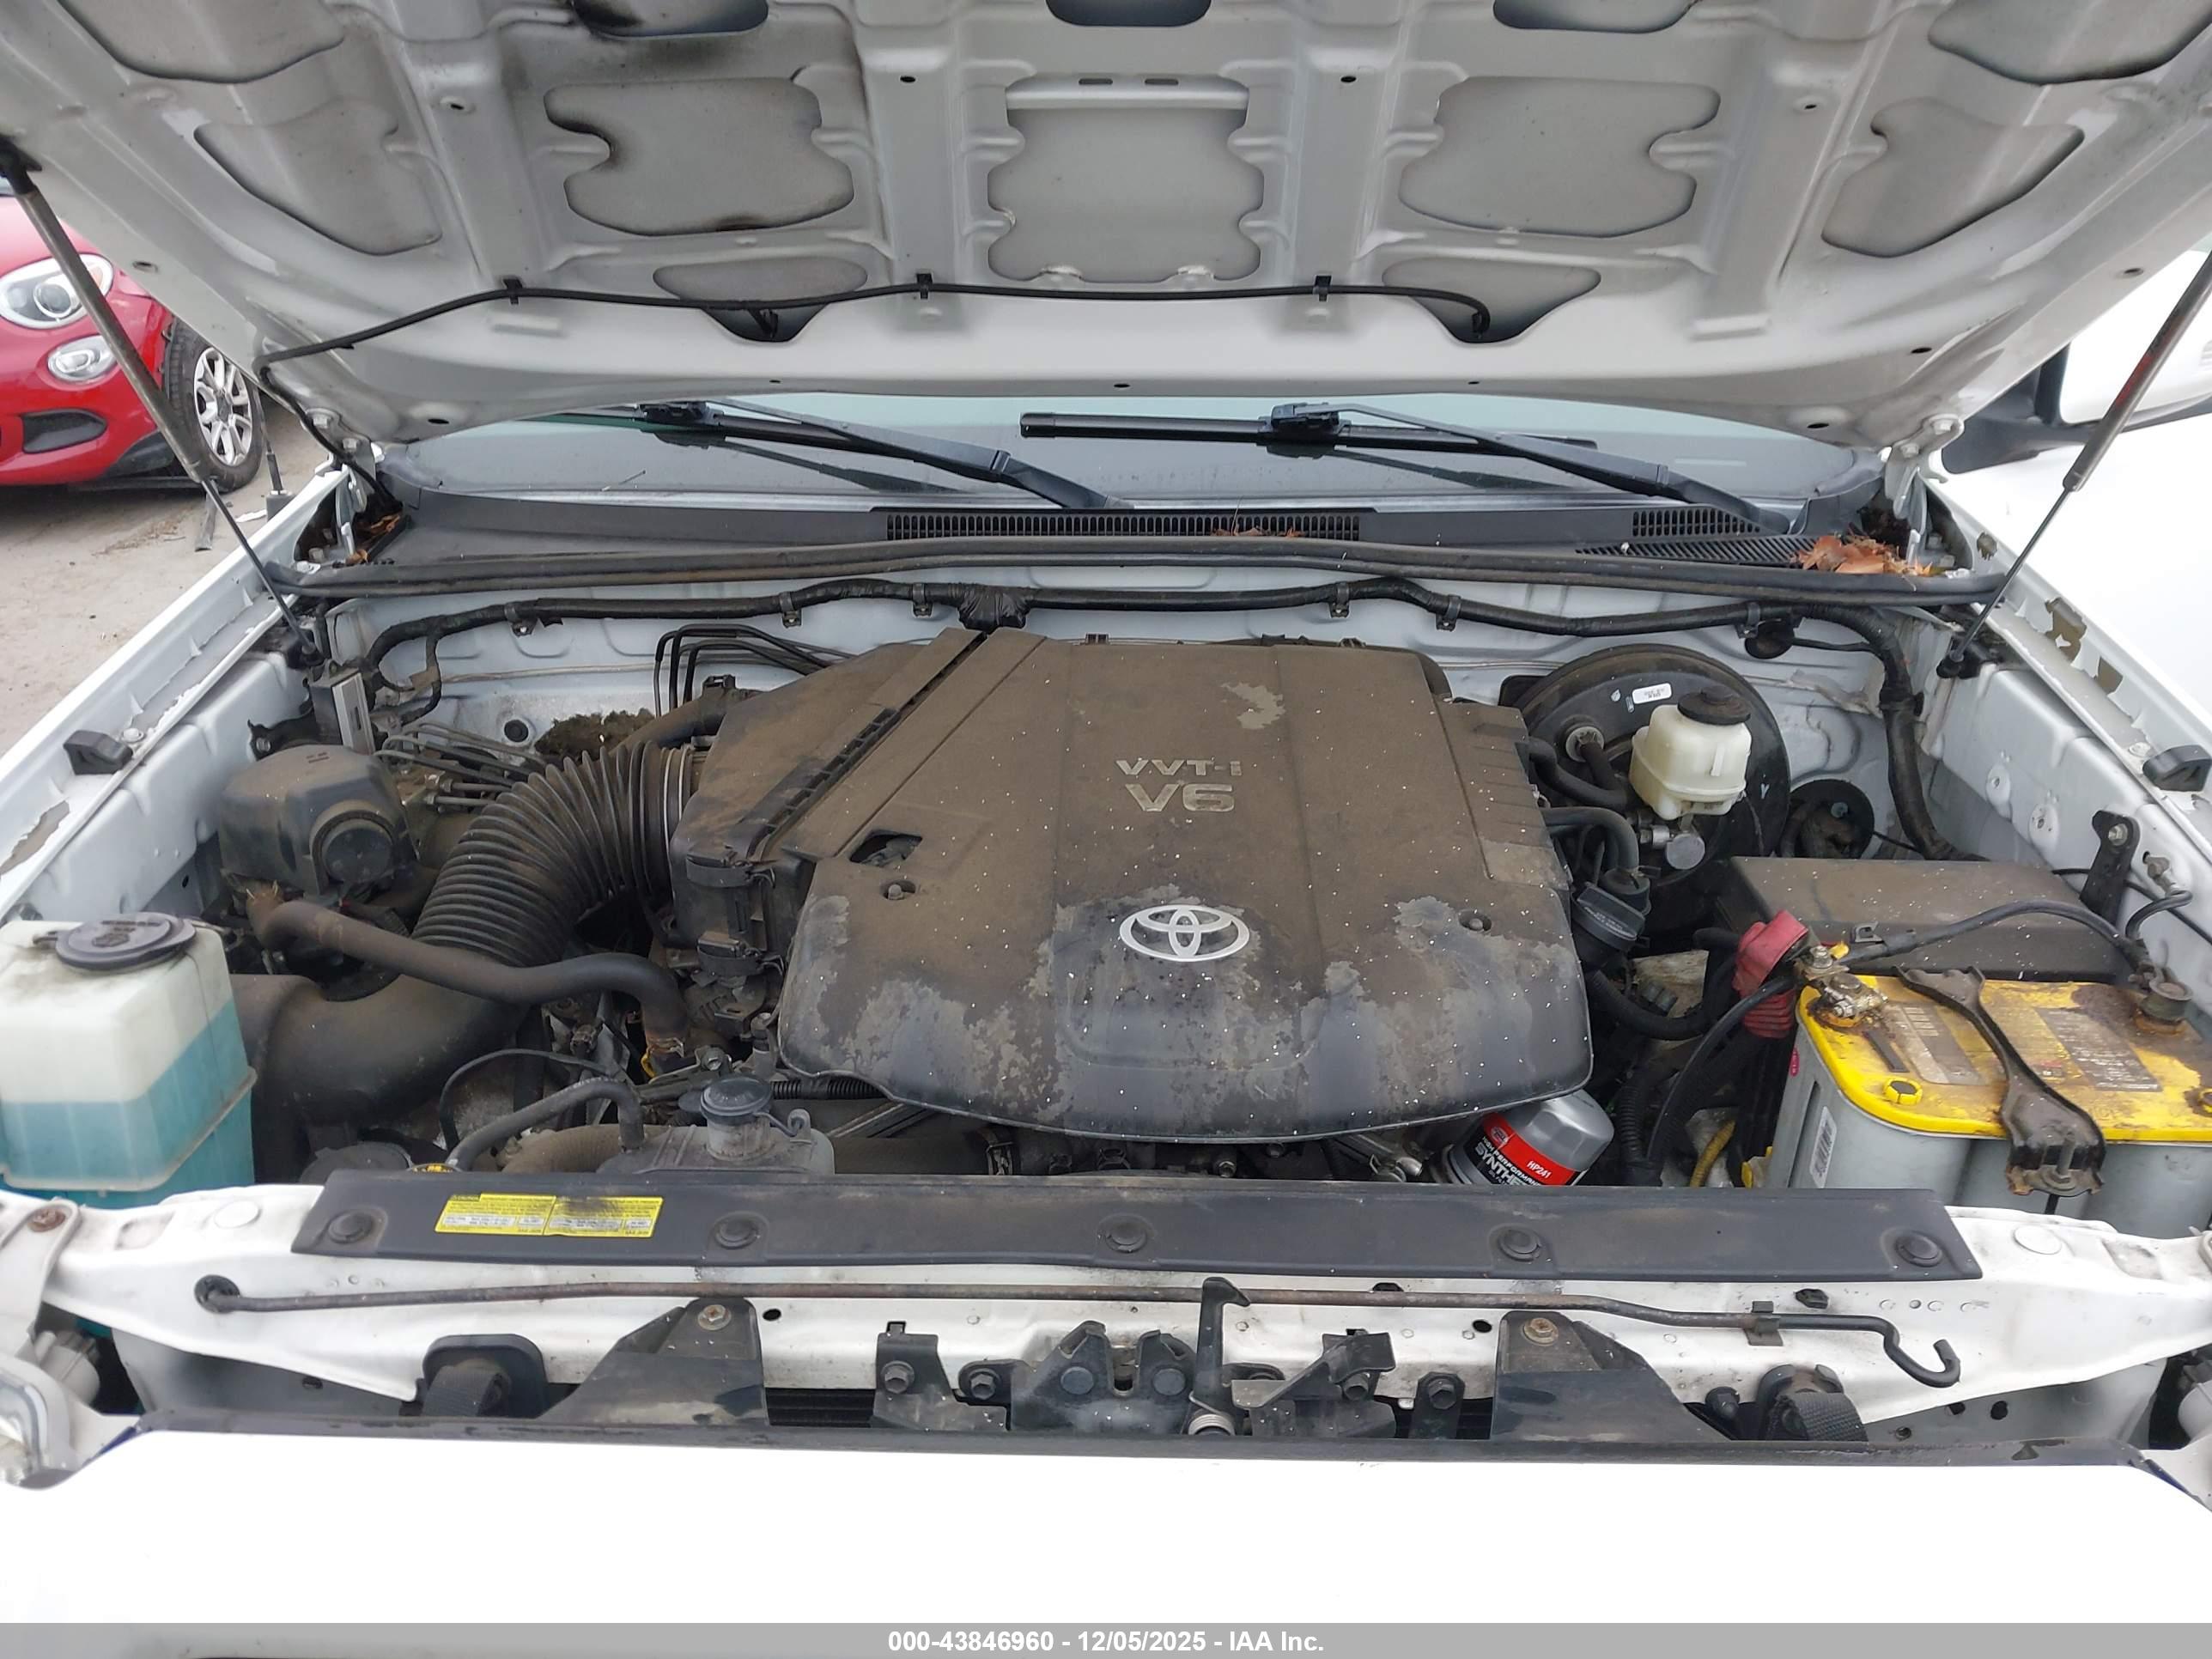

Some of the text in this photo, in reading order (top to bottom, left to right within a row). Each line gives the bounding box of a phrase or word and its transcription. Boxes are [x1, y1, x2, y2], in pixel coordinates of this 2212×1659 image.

[1125, 784, 1235, 811] V6
[1475, 1141, 1528, 1185] SYNTHE
[1493, 1149, 1542, 1186] PERFORMAN
[1526, 1160, 1553, 1179] HP241
